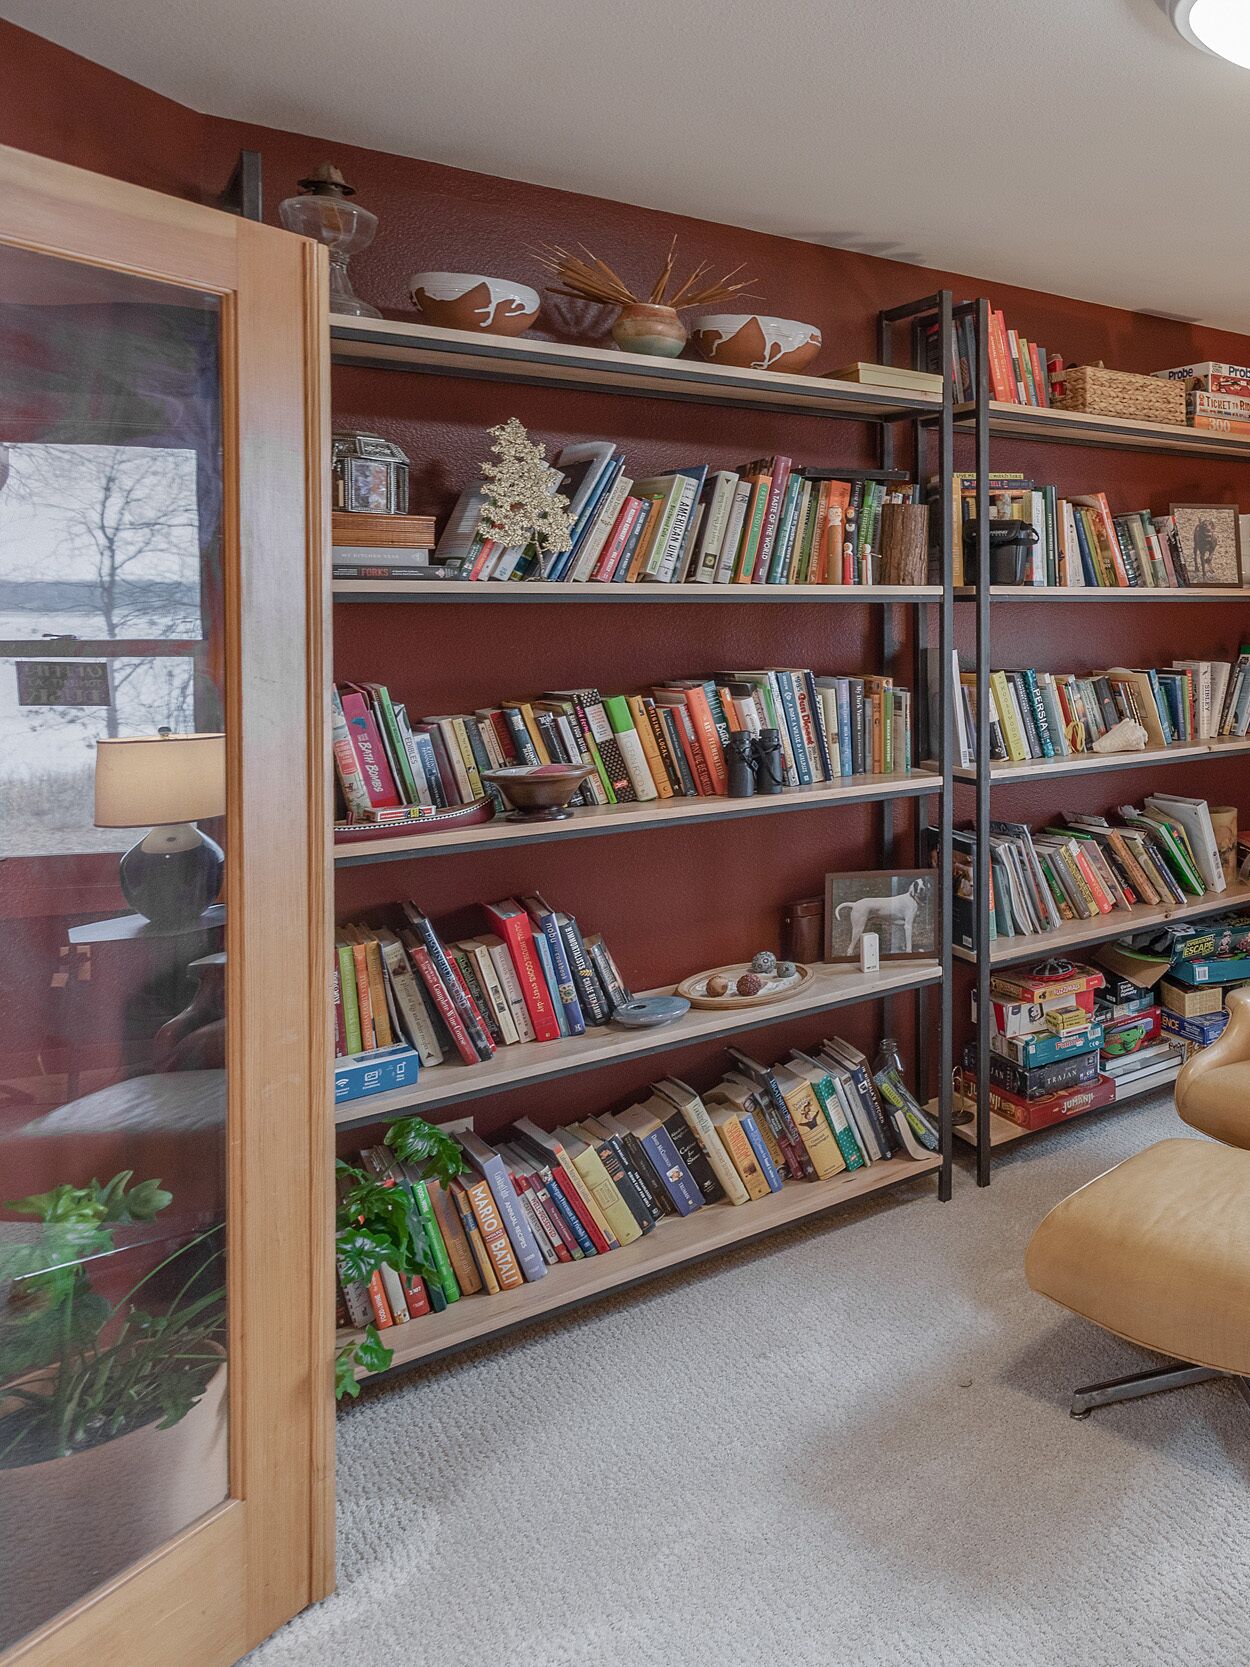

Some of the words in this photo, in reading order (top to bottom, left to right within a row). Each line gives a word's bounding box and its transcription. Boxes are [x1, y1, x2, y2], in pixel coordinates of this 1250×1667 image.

[1168, 367, 1194, 380] Probe
[1205, 395, 1231, 410] TICKET
[1208, 418, 1231, 433] 300
[756, 486, 766, 509] FRESH
[769, 495, 779, 512] TASTE
[664, 504, 676, 528] Birchwood
[669, 501, 689, 542] AMERICAN
[752, 510, 762, 532] INDIA
[768, 513, 775, 522] OF
[816, 500, 825, 528] WEEKEND
[765, 523, 773, 535] THE
[664, 543, 677, 563] DIRT
[760, 536, 771, 559] WORLD
[361, 568, 388, 577] FORKS
[855, 685, 861, 694] My
[797, 692, 809, 713] Gun
[1032, 687, 1048, 730] PERSIA
[572, 725, 581, 737] FOOD
[647, 705, 661, 735] ORIGINAL
[657, 737, 668, 757] LOCAL
[800, 713, 815, 746] Digest
[358, 741, 375, 765] BATH
[405, 737, 418, 765] EDIBLES
[710, 737, 724, 779] FERMENTATION
[365, 764, 384, 793] BOMBS
[519, 941, 529, 960] HOUSE
[545, 921, 558, 943] nobu
[554, 952, 567, 980] cookbook
[1184, 942, 1214, 958] ESCAPE
[496, 951, 508, 976] OREGON
[505, 977, 514, 993] TRAIL
[524, 960, 536, 982] COOKS
[566, 929, 586, 969] IMMORTALISTS
[581, 976, 594, 994] CHLOE
[588, 992, 603, 1019] BENJAMIN
[529, 982, 540, 999] every
[431, 982, 451, 1012] Complete
[445, 1009, 459, 1027] Wine
[453, 1024, 468, 1045] Course
[535, 1000, 545, 1013] day
[1163, 1015, 1179, 1030] ENCE
[1047, 1069, 1077, 1085] TRAJAN
[873, 1101, 884, 1124] KITCHEN
[1061, 1092, 1095, 1114] JUMANJI
[633, 1181, 642, 1191] CAMP
[472, 1185, 497, 1232] MARIO
[560, 1197, 574, 1216] Freeman
[573, 1219, 587, 1237] Friends
[504, 1201, 518, 1226] ANNUAL
[515, 1224, 527, 1249] RECIPES
[491, 1238, 518, 1284] BATALI
